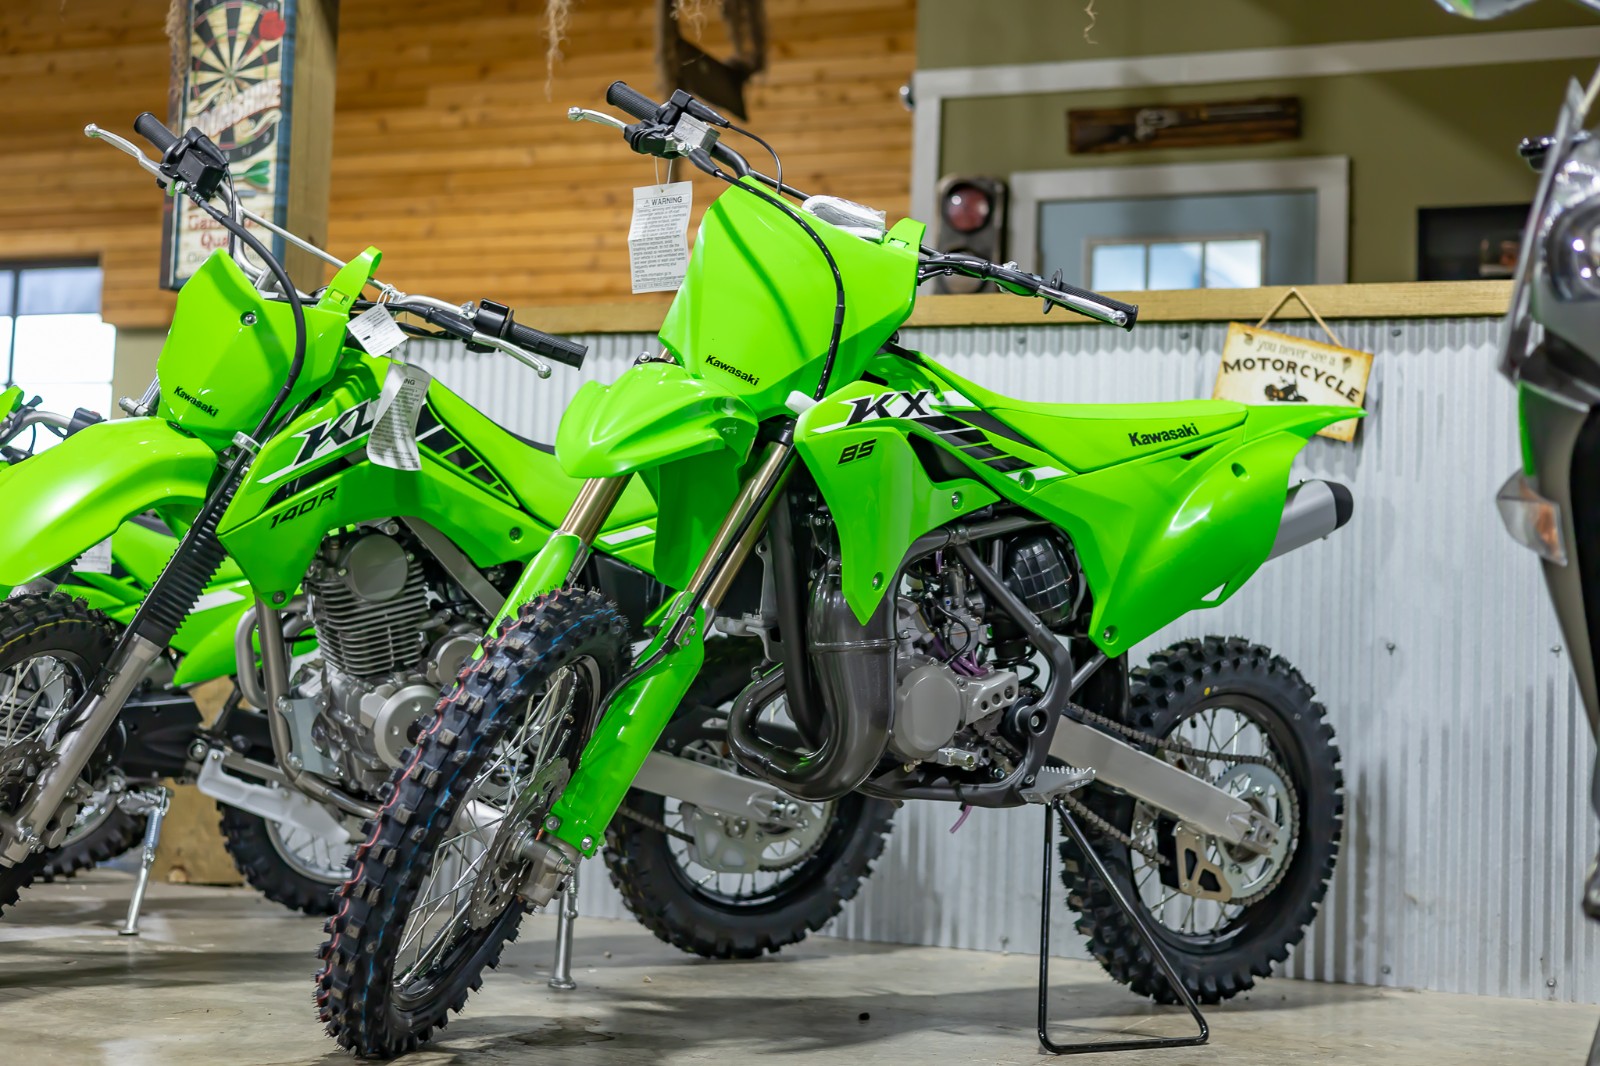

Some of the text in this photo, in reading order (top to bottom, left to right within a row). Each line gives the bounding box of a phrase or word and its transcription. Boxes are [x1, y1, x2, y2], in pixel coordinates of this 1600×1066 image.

[651, 195, 683, 207] WARNING
[1256, 339, 1277, 352] you
[1278, 343, 1307, 359] never
[1310, 352, 1328, 364] see
[705, 354, 760, 386] Kawasaki
[1222, 357, 1360, 403] MOTORCYCLE
[173, 385, 219, 418] Kawasaki
[846, 390, 930, 427] KX
[1127, 422, 1200, 447] Kawasaki
[837, 438, 878, 466] 85
[269, 486, 338, 530] 140R
